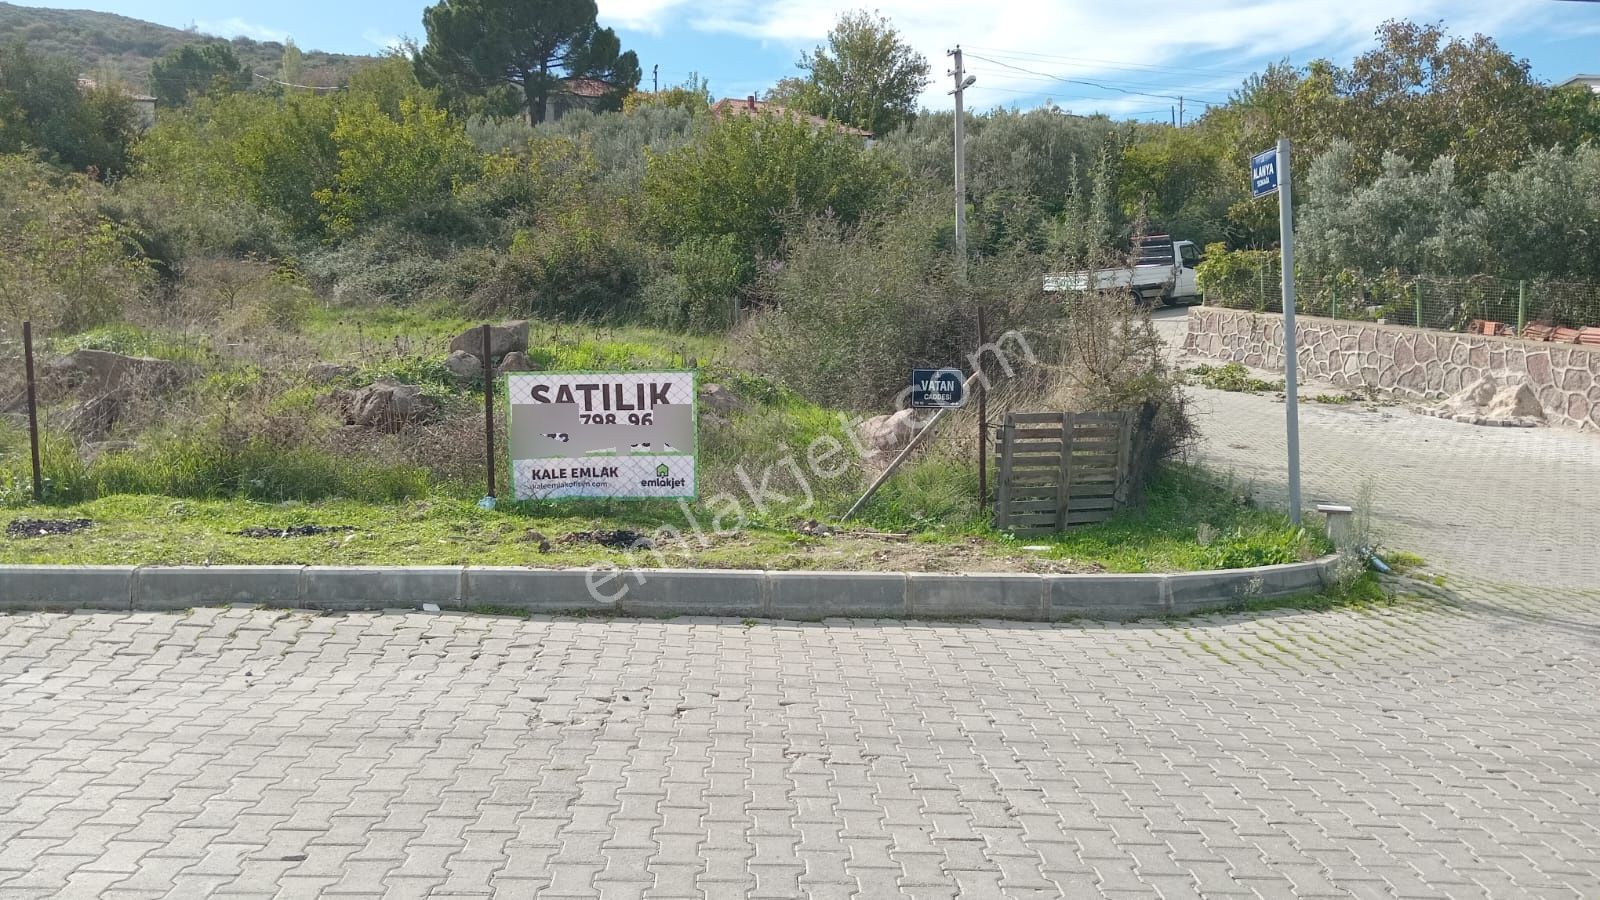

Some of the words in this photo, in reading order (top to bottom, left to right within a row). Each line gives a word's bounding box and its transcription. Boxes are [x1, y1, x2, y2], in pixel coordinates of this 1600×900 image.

[1253, 163, 1274, 179] ALANYA
[921, 380, 954, 391] VATAN
[530, 382, 672, 411] SATILIK
[924, 392, 951, 400] CADDESİ
[532, 468, 567, 480] KALE
[571, 466, 619, 478] EMLAK
[640, 477, 685, 489] emlakjet
